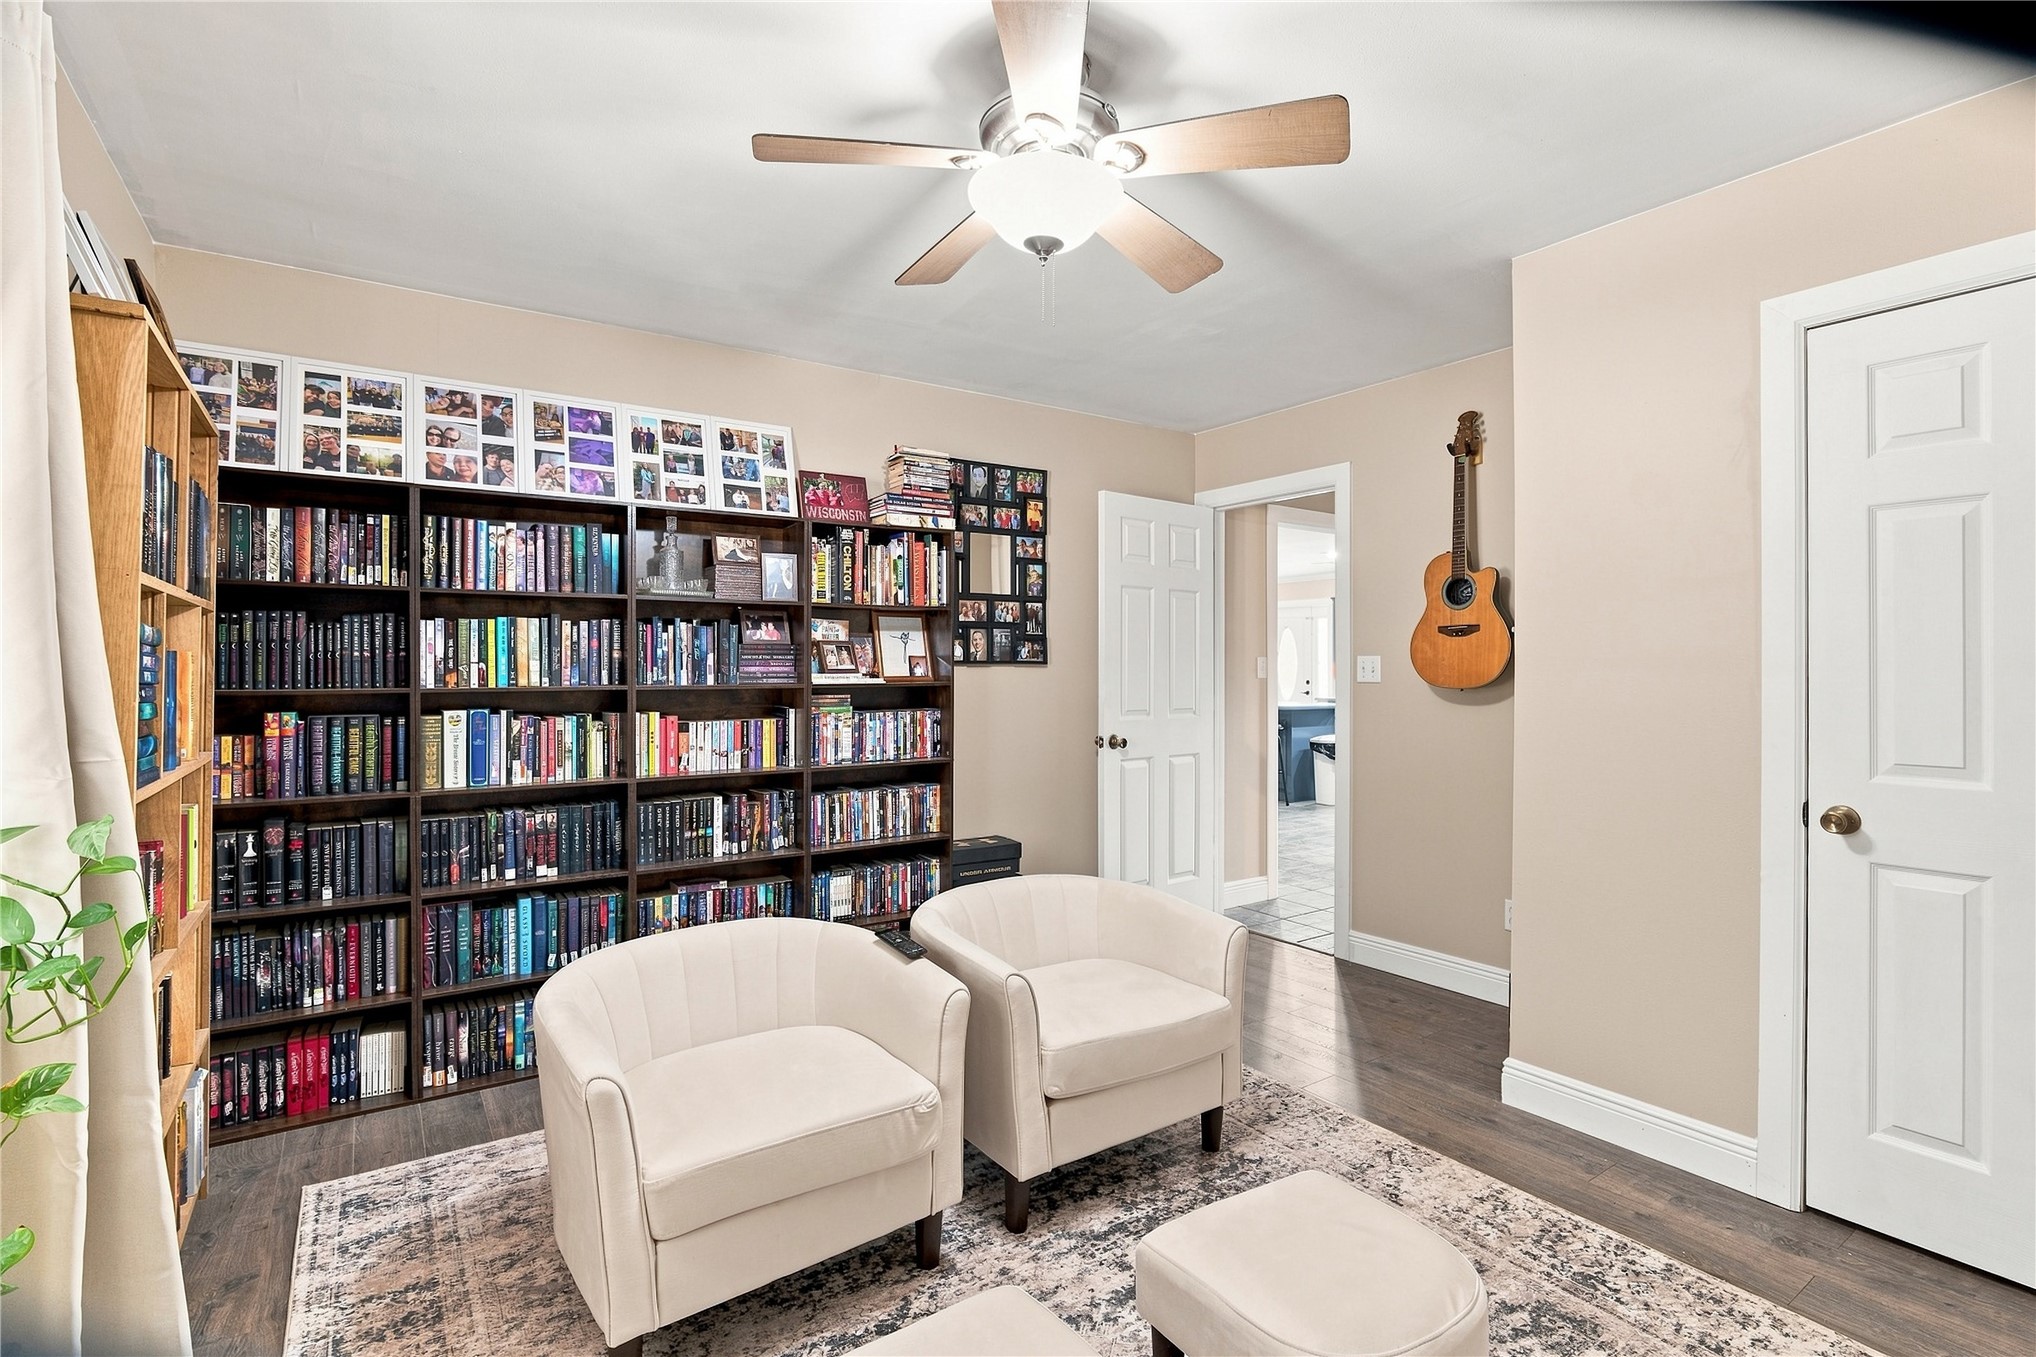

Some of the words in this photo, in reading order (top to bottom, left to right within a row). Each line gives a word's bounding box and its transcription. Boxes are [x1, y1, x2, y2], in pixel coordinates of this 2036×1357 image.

[805, 505, 867, 522] WISCONSIN
[843, 545, 852, 591] CHILTON
[959, 869, 983, 877] UNDER
[983, 865, 1012, 875] ARMOUR
